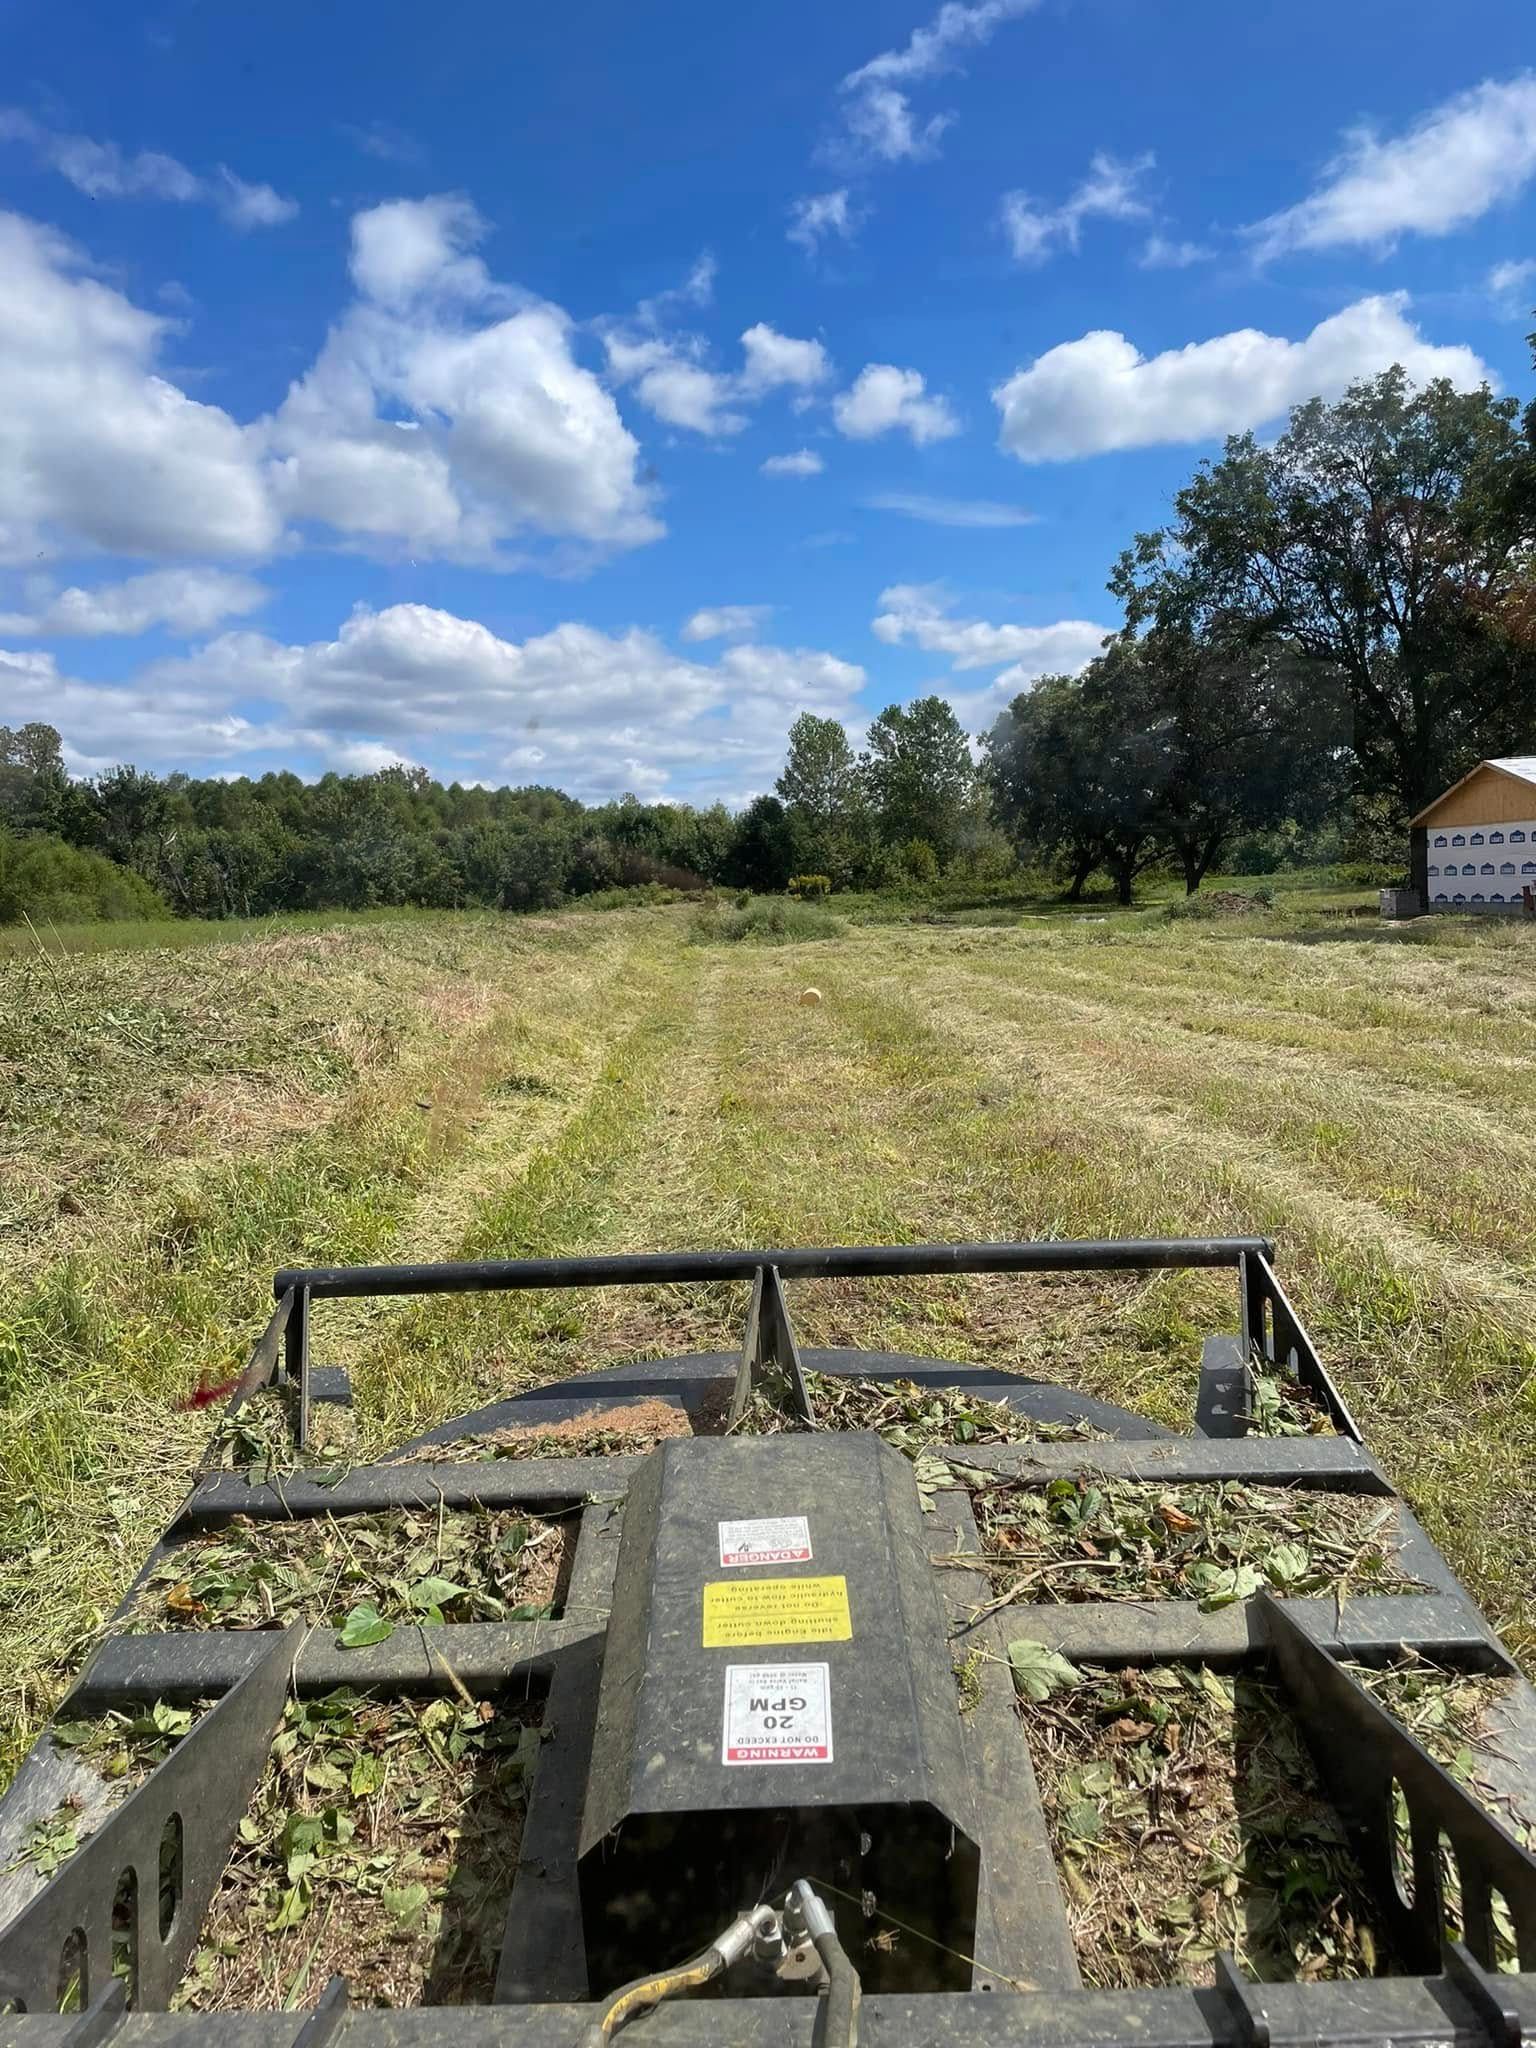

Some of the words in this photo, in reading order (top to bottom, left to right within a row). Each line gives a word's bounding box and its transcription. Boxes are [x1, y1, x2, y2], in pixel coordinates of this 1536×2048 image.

[728, 1550, 791, 1563] DANGER
[731, 1584, 786, 1593] operating
[790, 1591, 843, 1600] hydraulic
[790, 1617, 839, 1625] shutting
[768, 1628, 806, 1637] Engine
[750, 1697, 807, 1711] GPM
[763, 1715, 793, 1729] 20
[737, 1736, 777, 1744] EXCEED
[781, 1736, 801, 1744] NOT
[736, 1748, 819, 1760] WARNING
